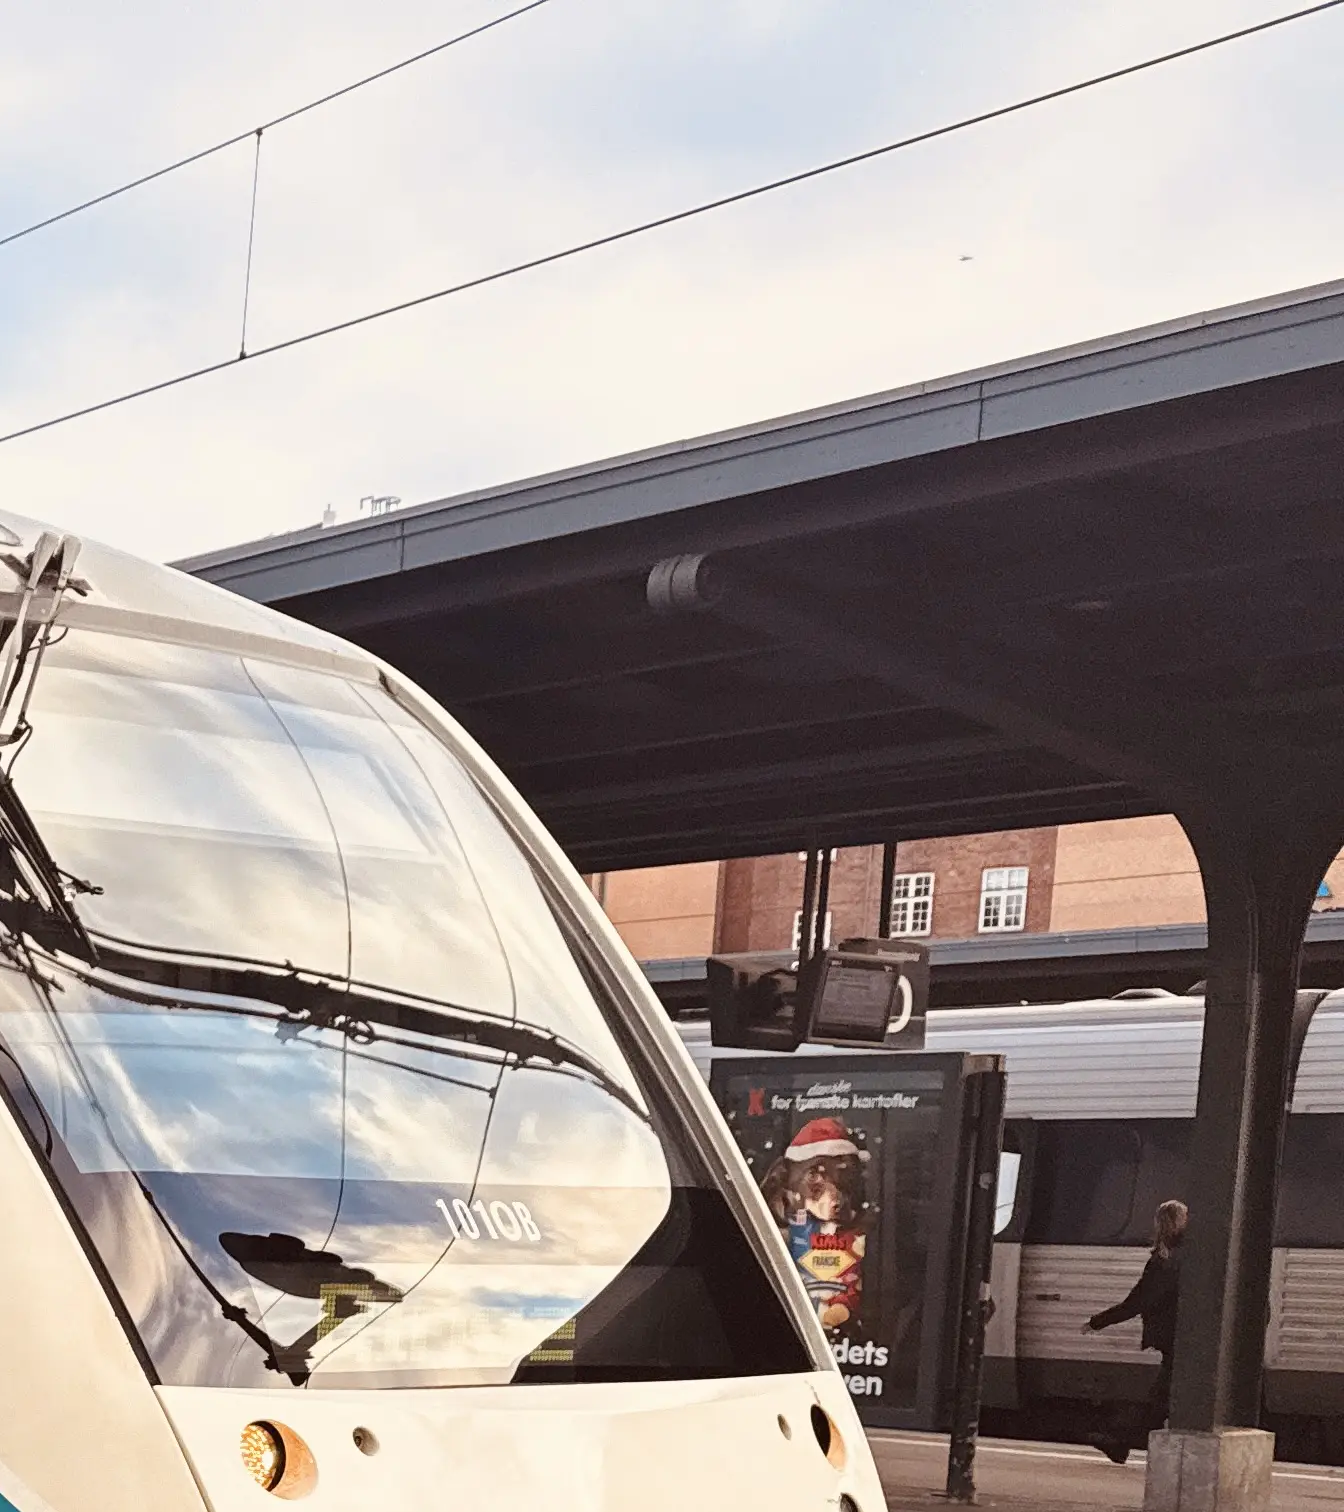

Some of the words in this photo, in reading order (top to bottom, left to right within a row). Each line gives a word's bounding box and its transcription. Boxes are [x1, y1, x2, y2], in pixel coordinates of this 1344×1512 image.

[771, 1094, 792, 1110] for
[852, 1093, 919, 1109] kartofler
[830, 1337, 889, 1367] dets
